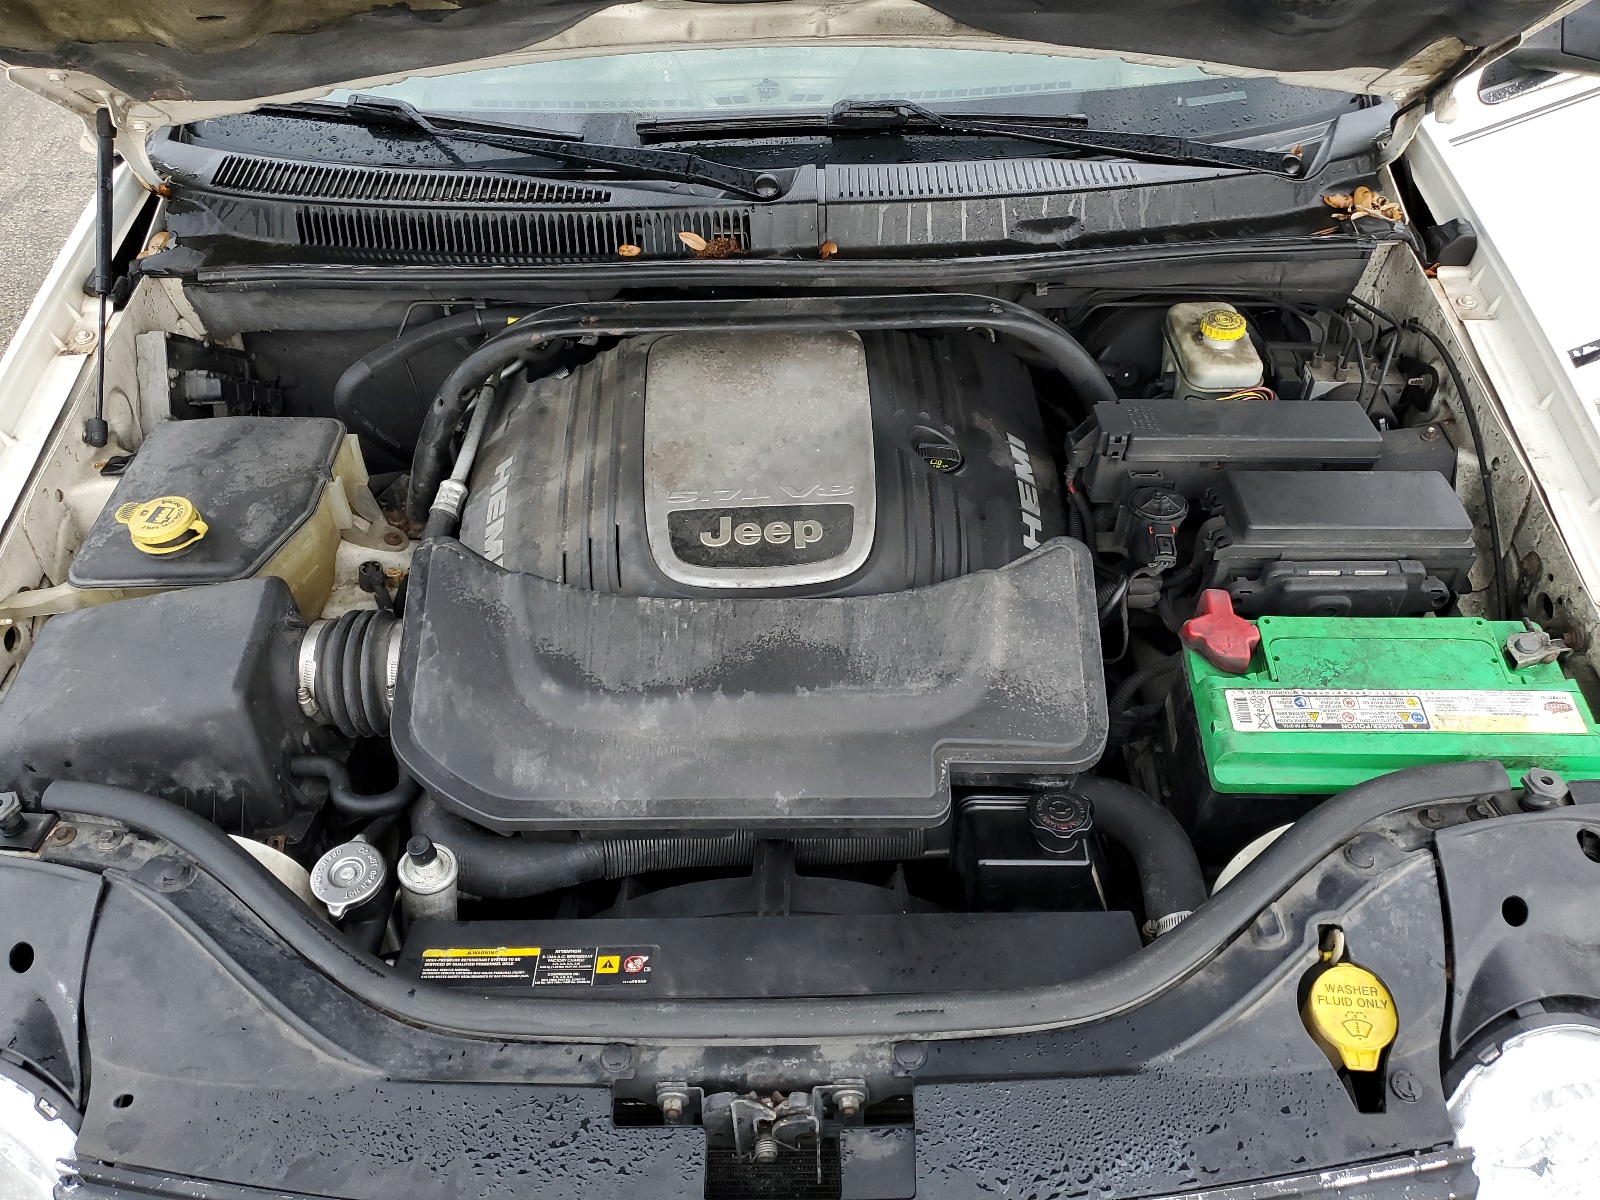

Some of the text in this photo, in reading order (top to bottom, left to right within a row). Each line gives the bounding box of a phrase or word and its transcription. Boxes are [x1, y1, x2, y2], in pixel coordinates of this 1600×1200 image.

[667, 482, 854, 503] 5.7L V8
[1006, 431, 1042, 551] HEMI
[699, 516, 823, 549] Jeep
[358, 847, 370, 856] DO
[315, 849, 343, 894] OPEN SLOWLY
[362, 869, 378, 890] OPEN
[343, 888, 361, 899] HOT
[1324, 983, 1379, 997] WASHER
[1317, 994, 1388, 1010] FLUID ONLY
